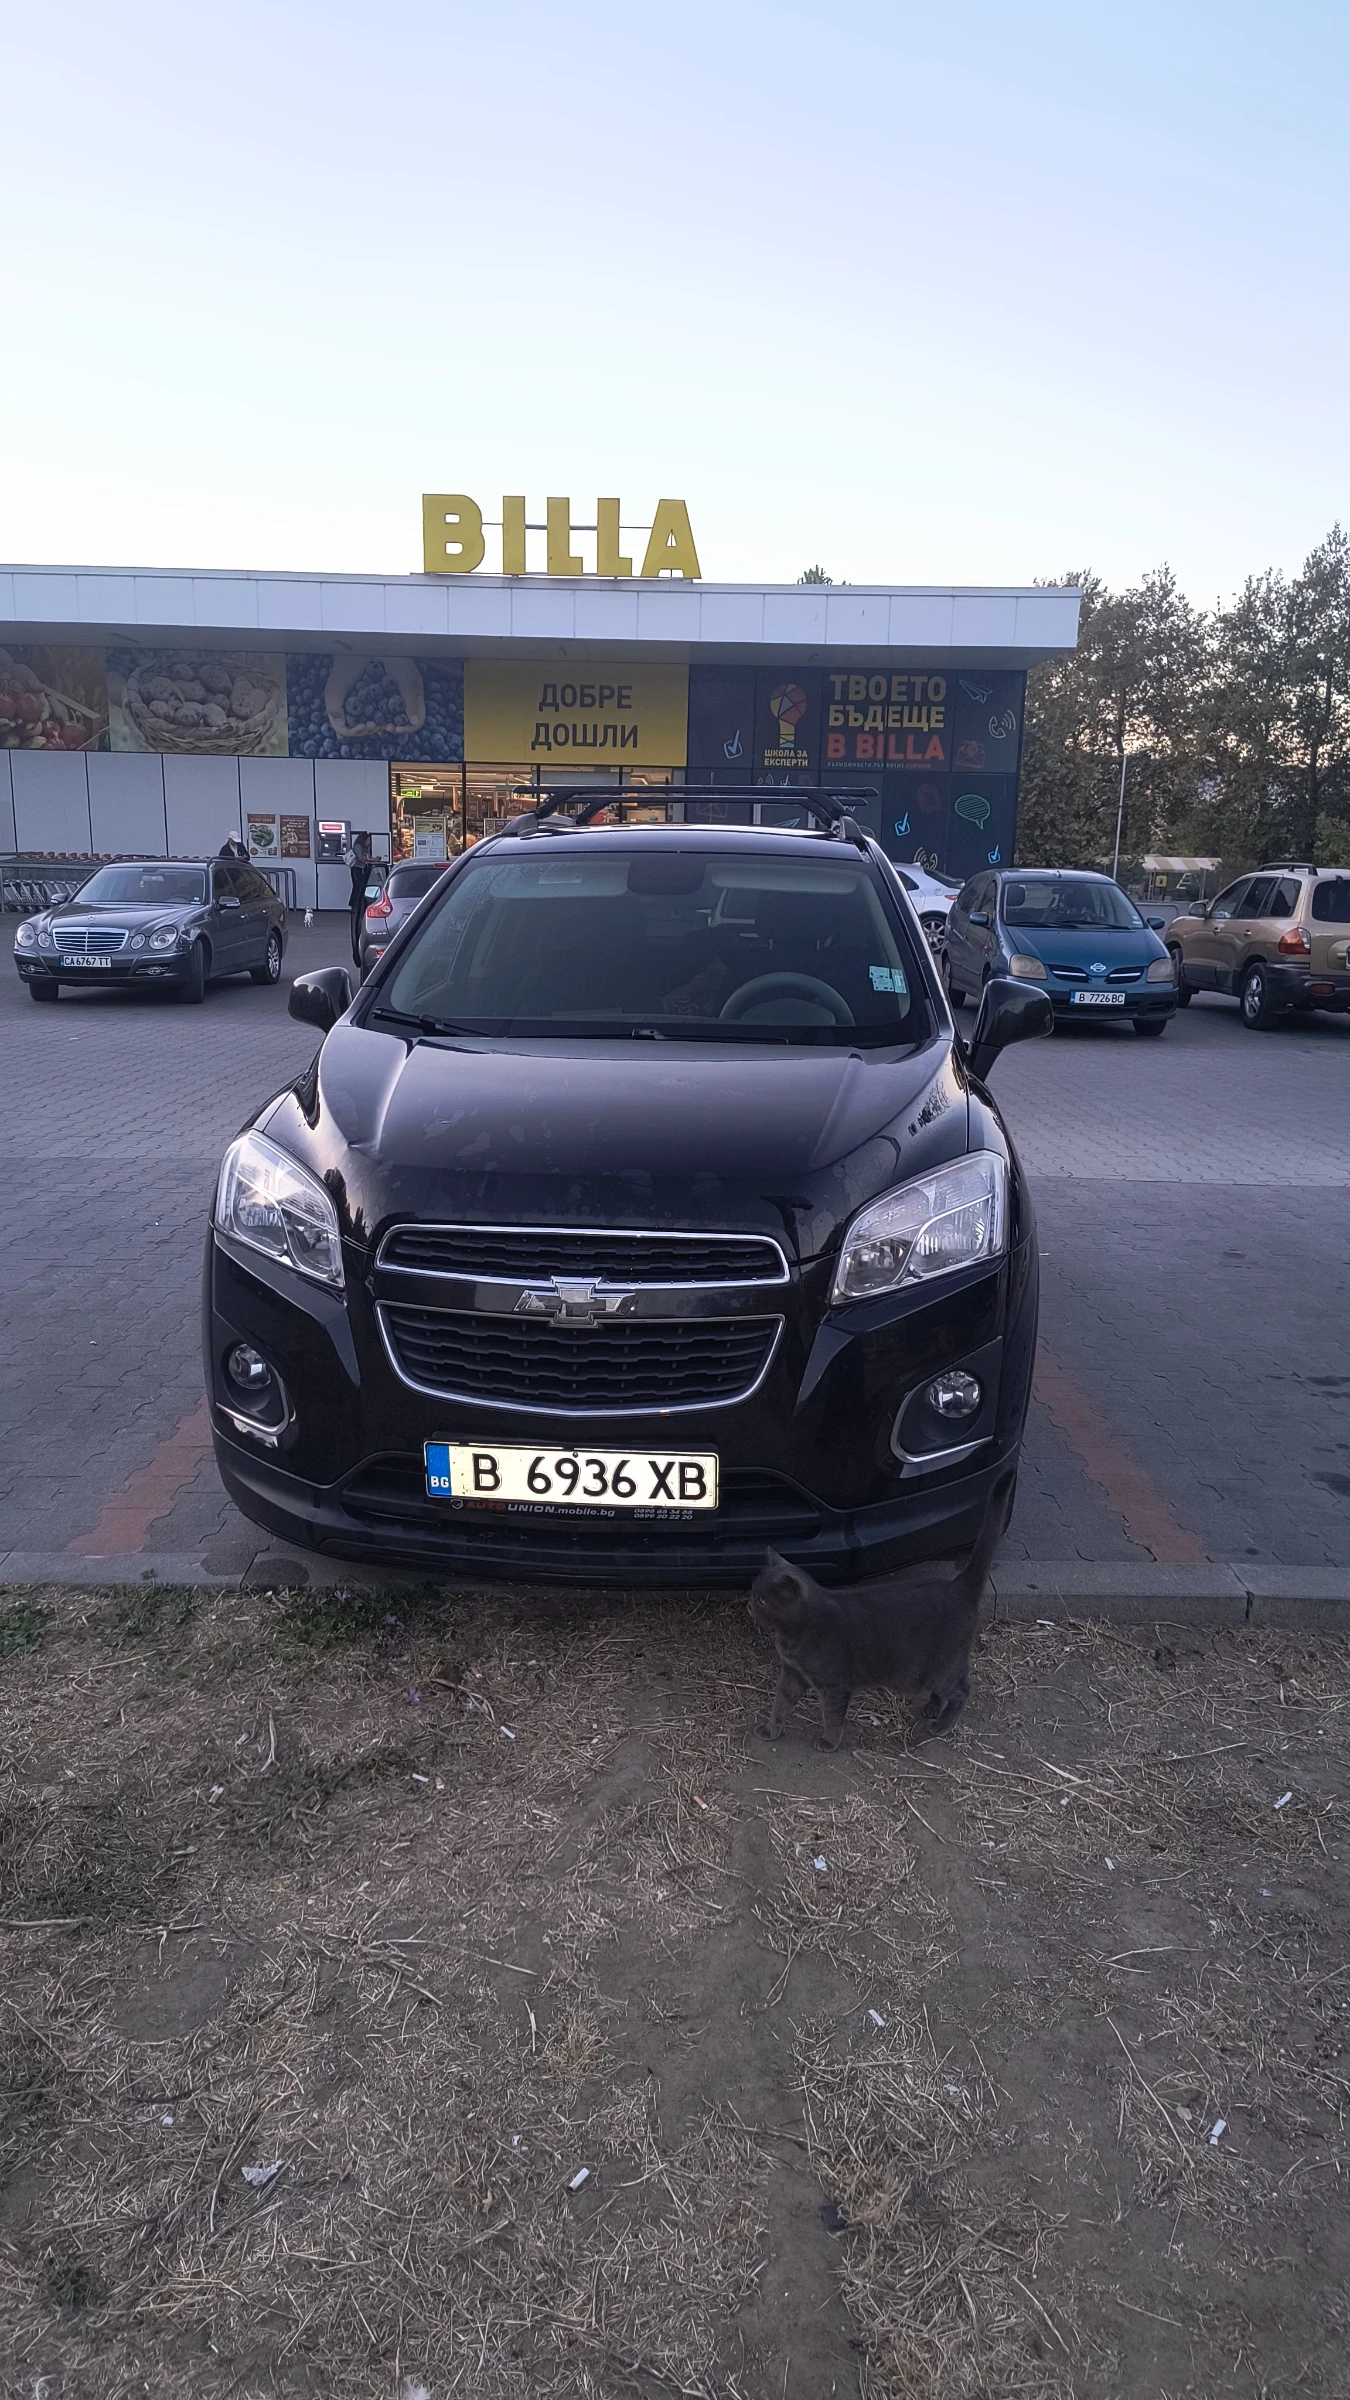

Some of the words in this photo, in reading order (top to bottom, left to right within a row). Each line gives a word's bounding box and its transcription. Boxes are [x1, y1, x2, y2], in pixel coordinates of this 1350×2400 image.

[422, 494, 702, 579] BILLA
[538, 683, 633, 713] ДОБРЕ
[829, 674, 947, 702] ТВОЕТО
[828, 704, 946, 732] БЪДЕЩЕ
[530, 722, 639, 751] ДОШЛИ
[827, 733, 846, 760] В
[855, 733, 945, 761] BILLA
[764, 749, 795, 758] ШКОЛА
[796, 749, 808, 758] ЗА
[764, 758, 808, 767] ЕКСПЕРТИ
[64, 956, 75, 966] CA
[76, 956, 97, 966] 6767
[98, 957, 110, 966] TT
[1079, 993, 1086, 1002] B
[1089, 993, 1111, 1003] 7726
[1111, 994, 1124, 1003] BC
[430, 1475, 450, 1488] BG
[471, 1452, 502, 1492] B
[526, 1456, 638, 1499] 6936
[647, 1459, 708, 1501] XB
